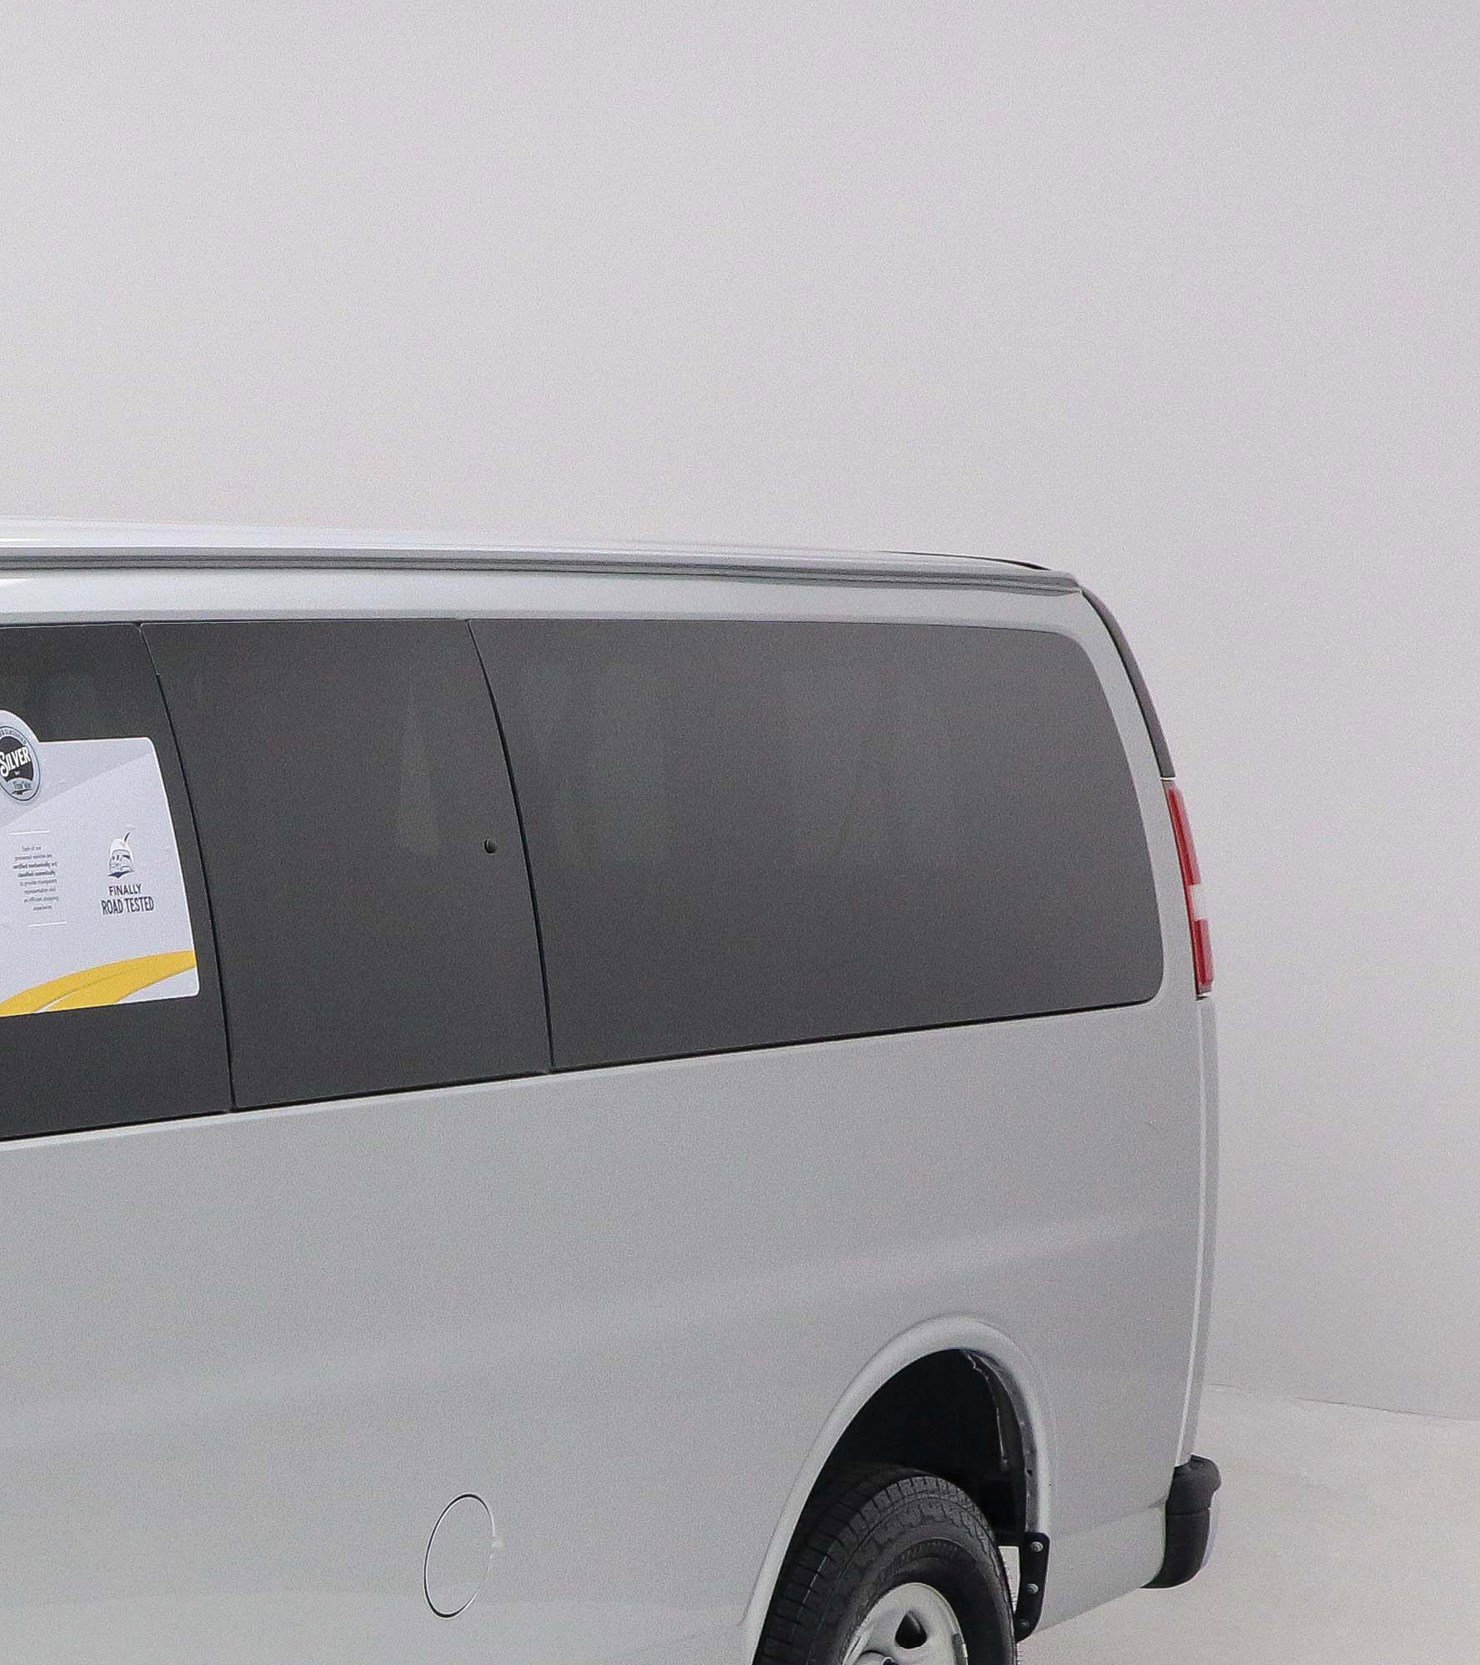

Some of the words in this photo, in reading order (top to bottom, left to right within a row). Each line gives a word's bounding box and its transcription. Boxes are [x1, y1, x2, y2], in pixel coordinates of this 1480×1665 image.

[108, 883, 142, 896] FINALLY
[101, 899, 124, 915] ROAD
[124, 896, 155, 913] TESTED
